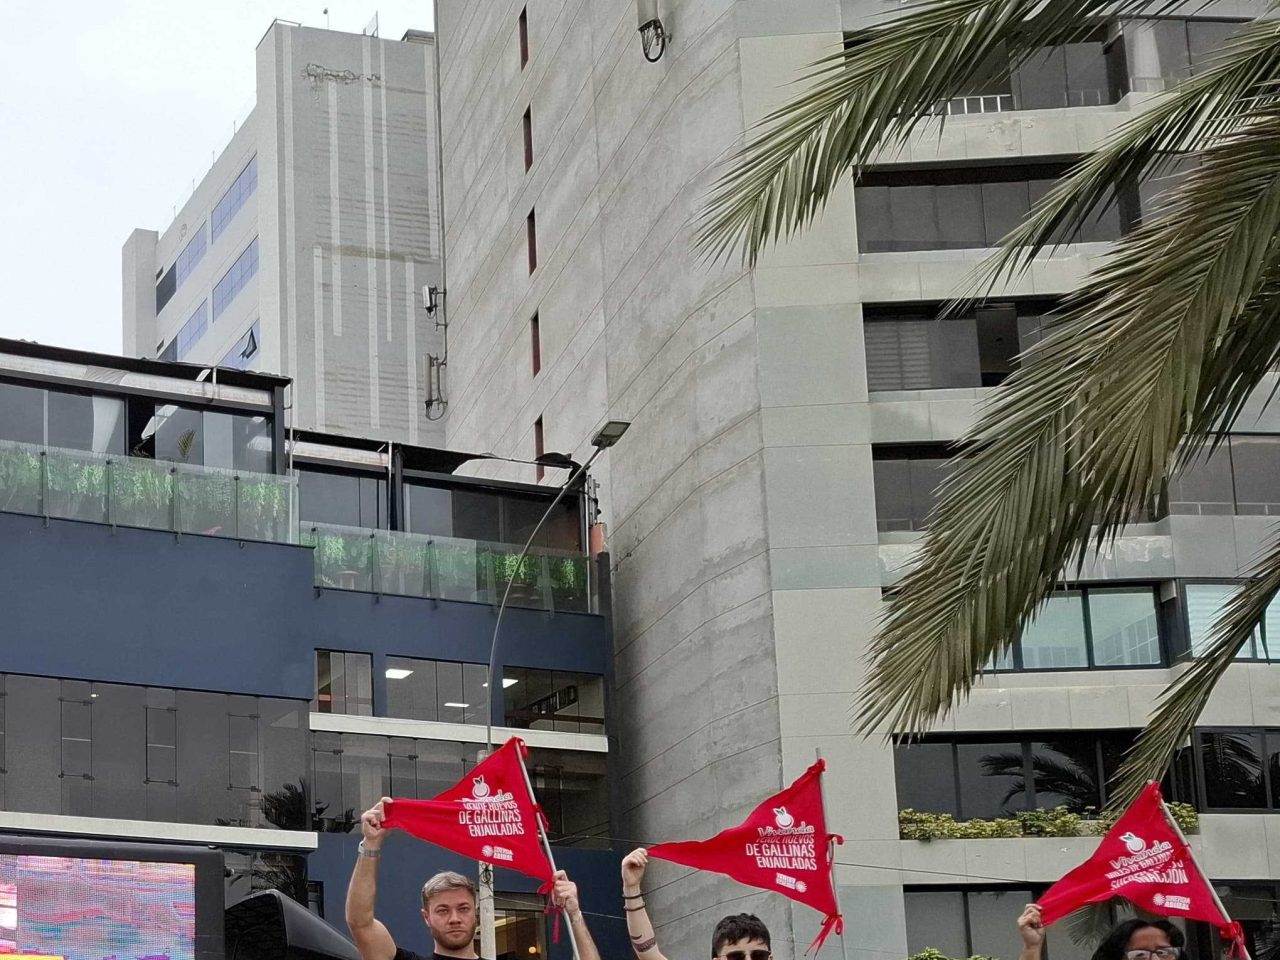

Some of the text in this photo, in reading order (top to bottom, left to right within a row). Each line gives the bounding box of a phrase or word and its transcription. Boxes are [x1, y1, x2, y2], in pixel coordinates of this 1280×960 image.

[459, 809, 522, 825] DE GALLINAS
[469, 822, 524, 837] ENJAULADAS
[745, 843, 816, 858] DE GALLINAS
[756, 856, 817, 871] ENJAULADAS
